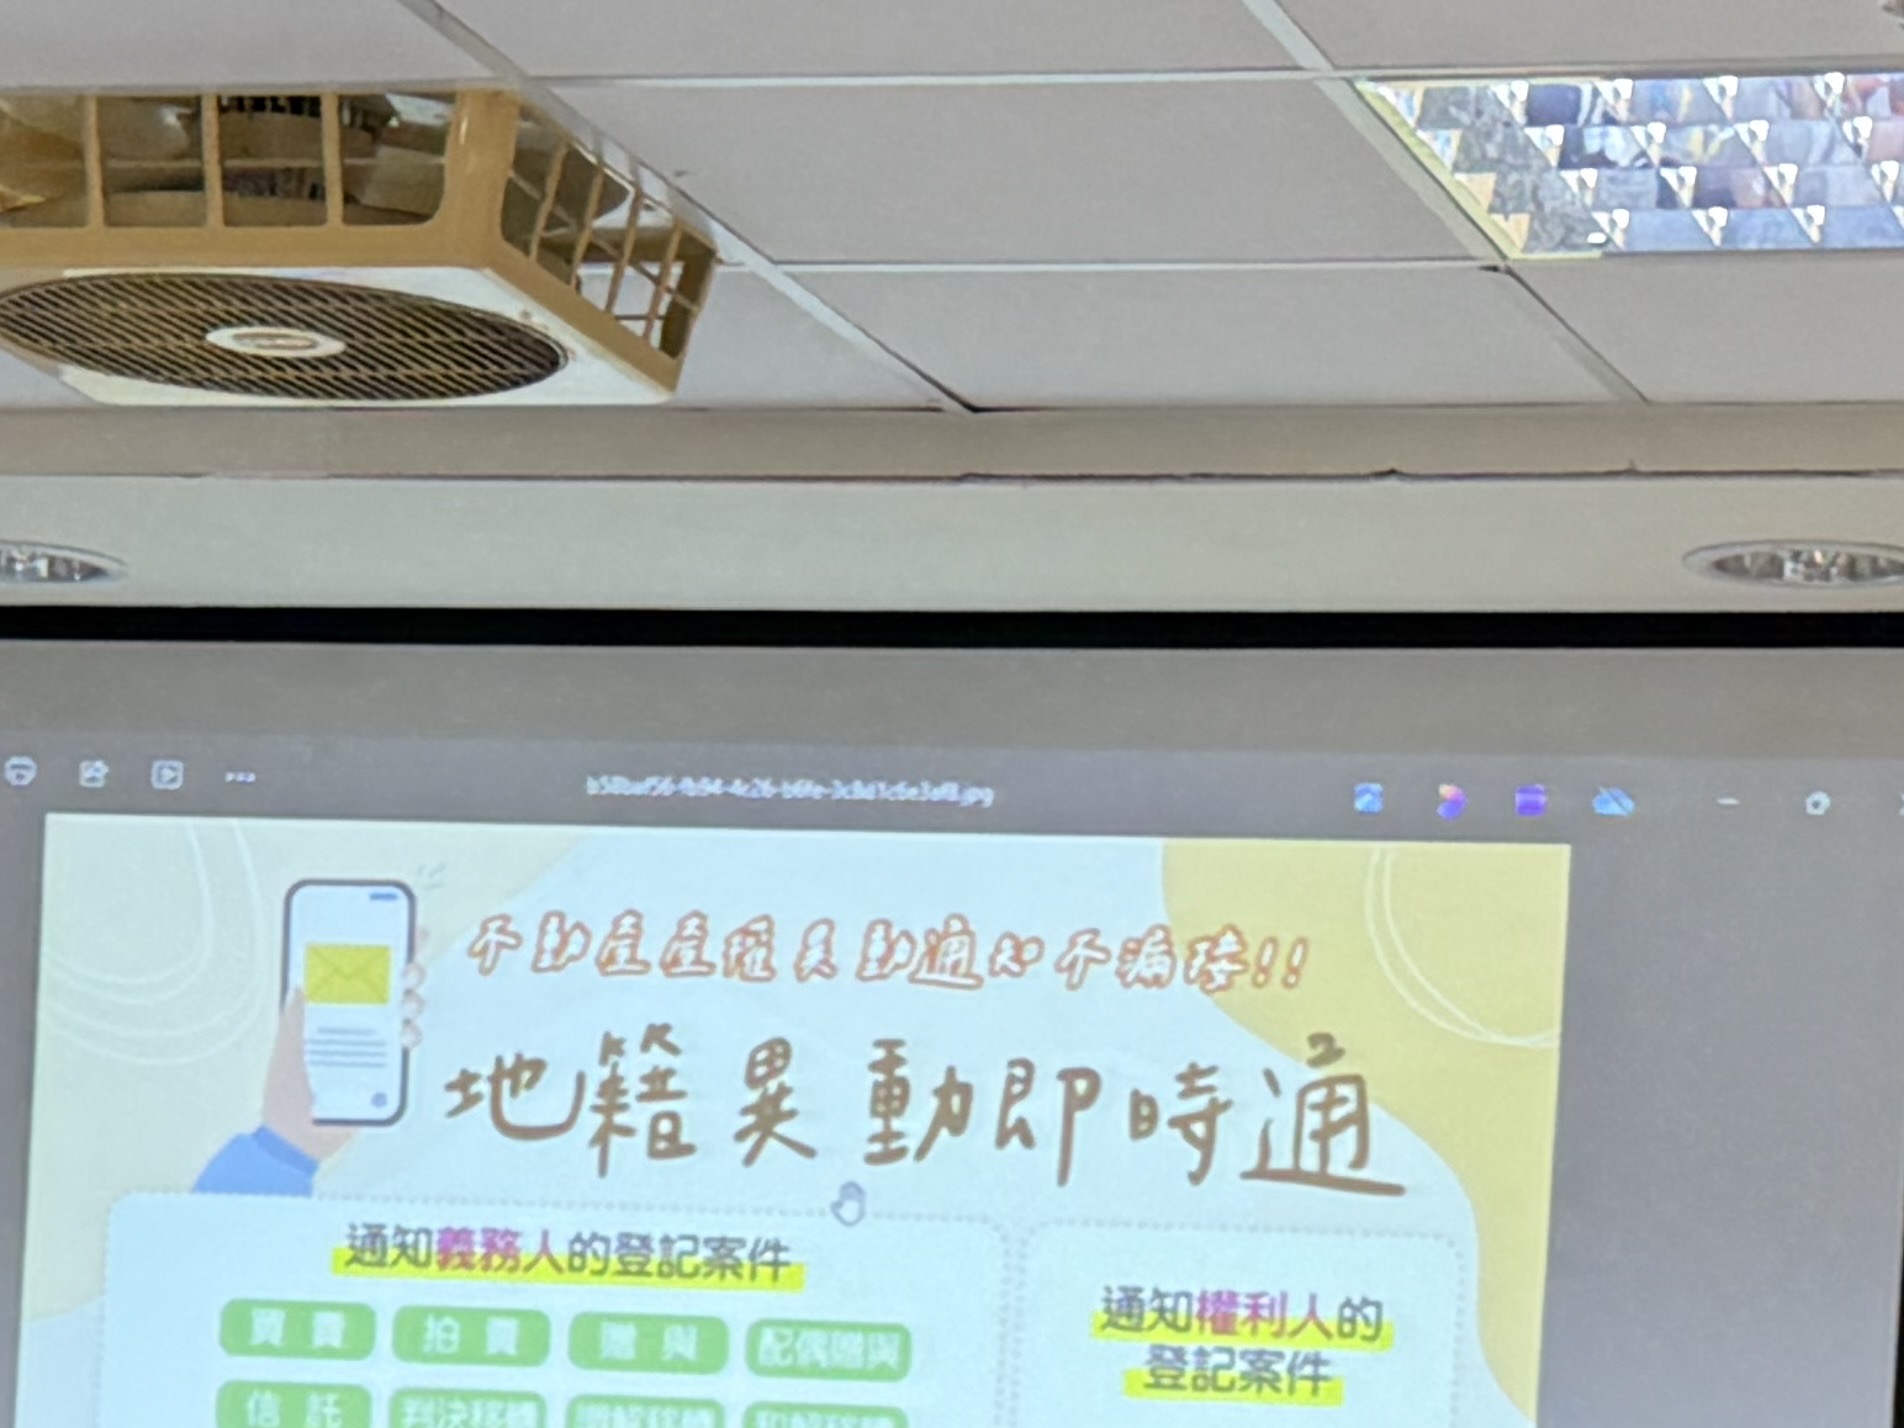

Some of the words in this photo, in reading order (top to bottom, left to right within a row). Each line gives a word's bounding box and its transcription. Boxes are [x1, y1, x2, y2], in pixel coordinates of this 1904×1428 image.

[443, 1023, 1404, 1195] 地籍異動即時通
[344, 1223, 792, 1283] 通知義務人的登記案件
[1099, 1284, 1384, 1342] 通知權利人的
[757, 1326, 901, 1371] 配偶贈與
[1143, 1343, 1332, 1397] 登記案件
